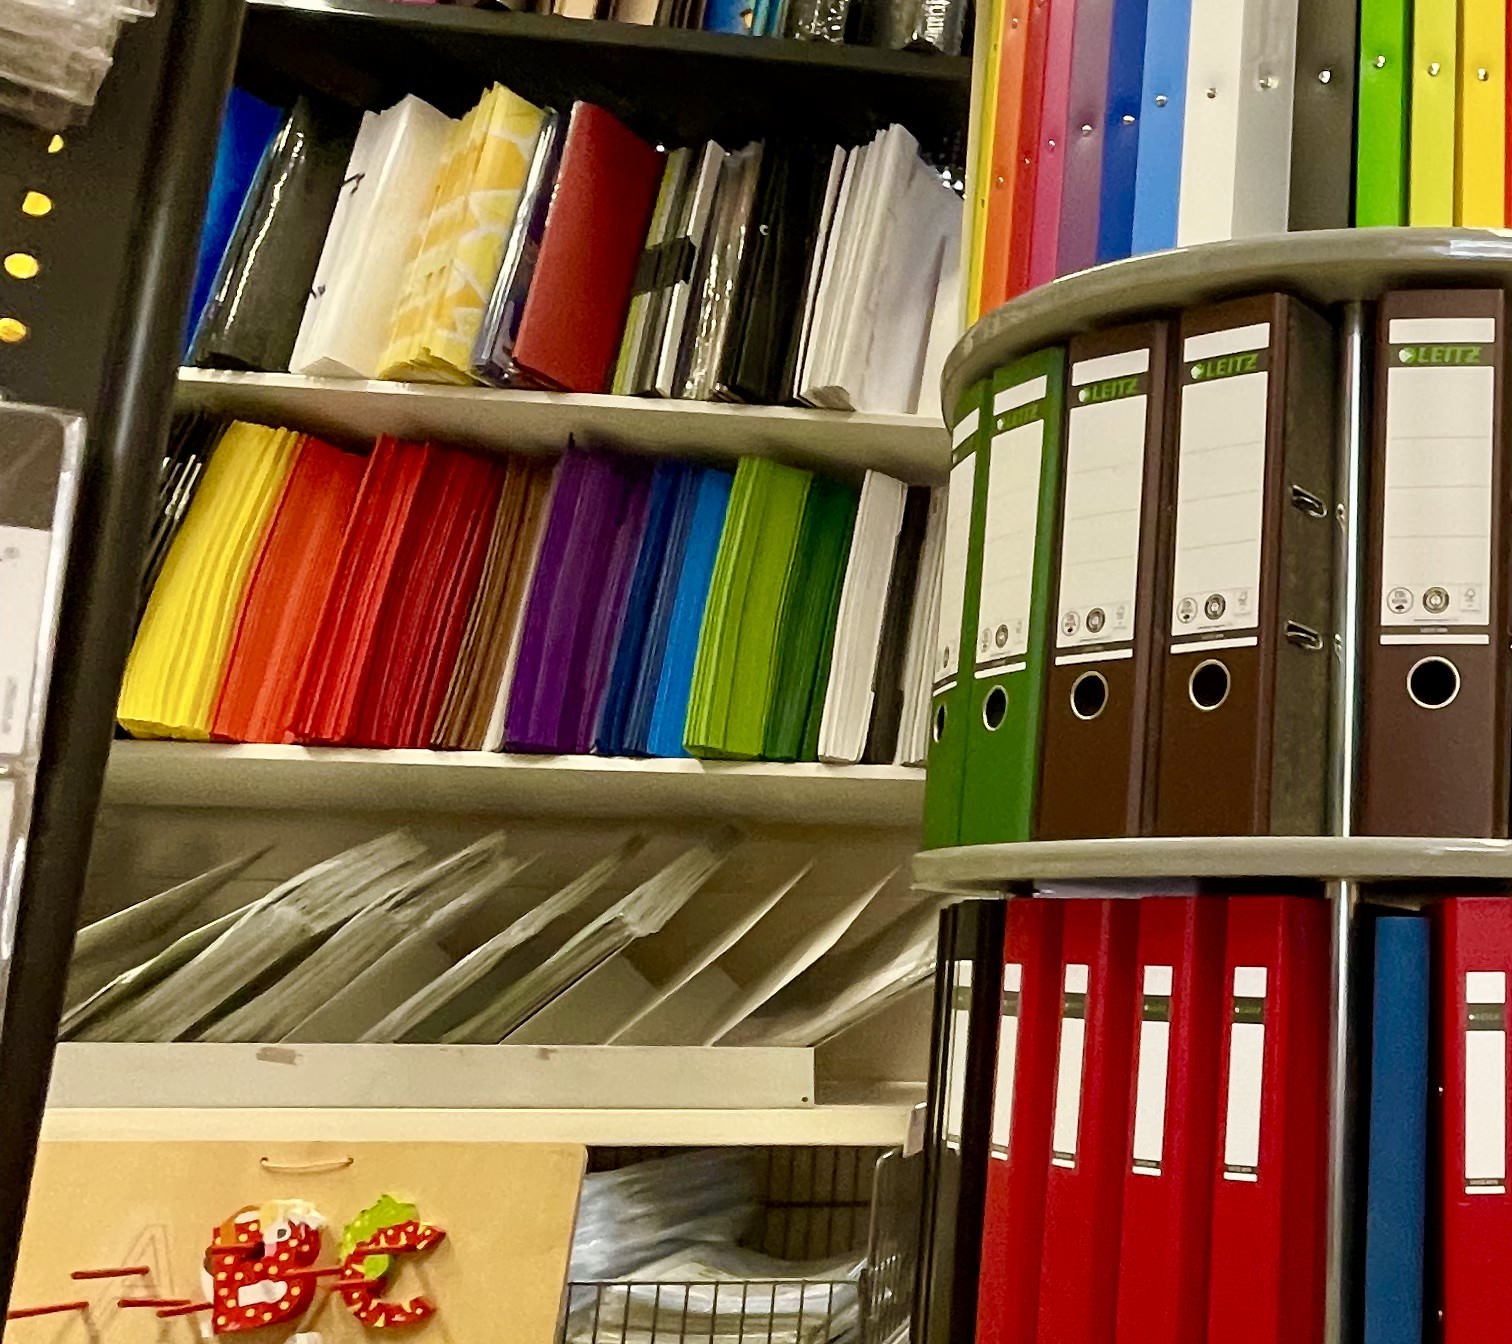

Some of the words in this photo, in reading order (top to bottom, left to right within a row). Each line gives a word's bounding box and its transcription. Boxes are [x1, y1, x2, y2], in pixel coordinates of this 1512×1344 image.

[1207, 353, 1259, 378] LEITZ
[1417, 346, 1483, 364] LEITZ
[1091, 377, 1139, 402] LEITZ
